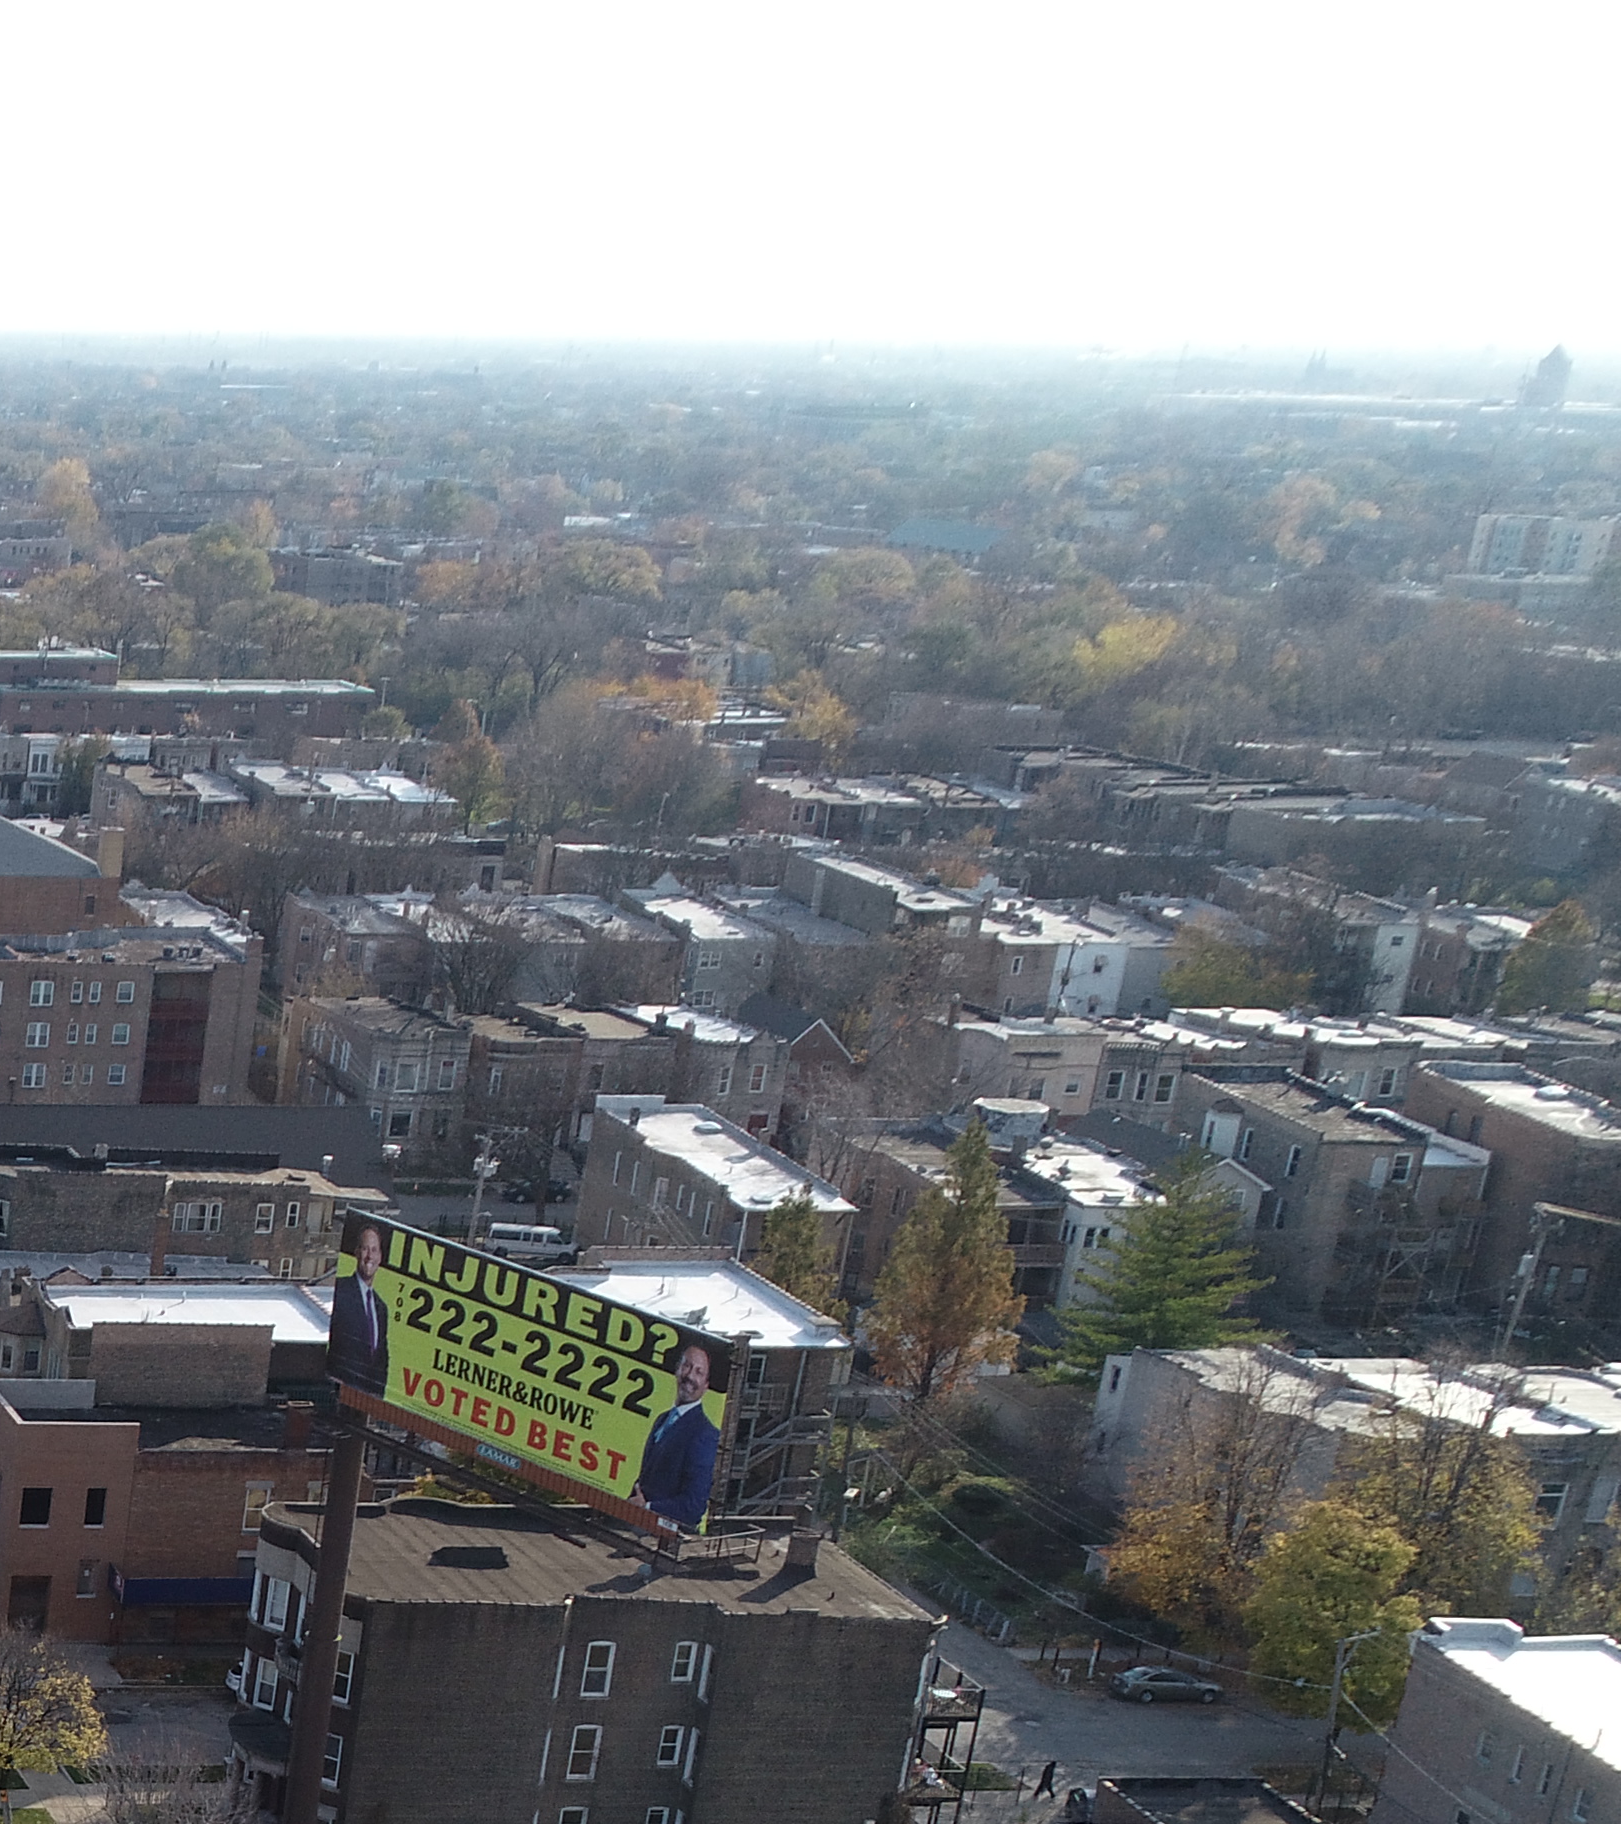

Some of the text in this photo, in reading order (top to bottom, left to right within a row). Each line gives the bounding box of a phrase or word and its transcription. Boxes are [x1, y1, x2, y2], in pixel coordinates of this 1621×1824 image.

[388, 1229, 680, 1364] INJURED?
[406, 1286, 655, 1419] 222-2222
[402, 1366, 517, 1438] VOTED
[526, 1418, 628, 1481] BEST
[432, 1347, 594, 1431] LERNER&ROWE
